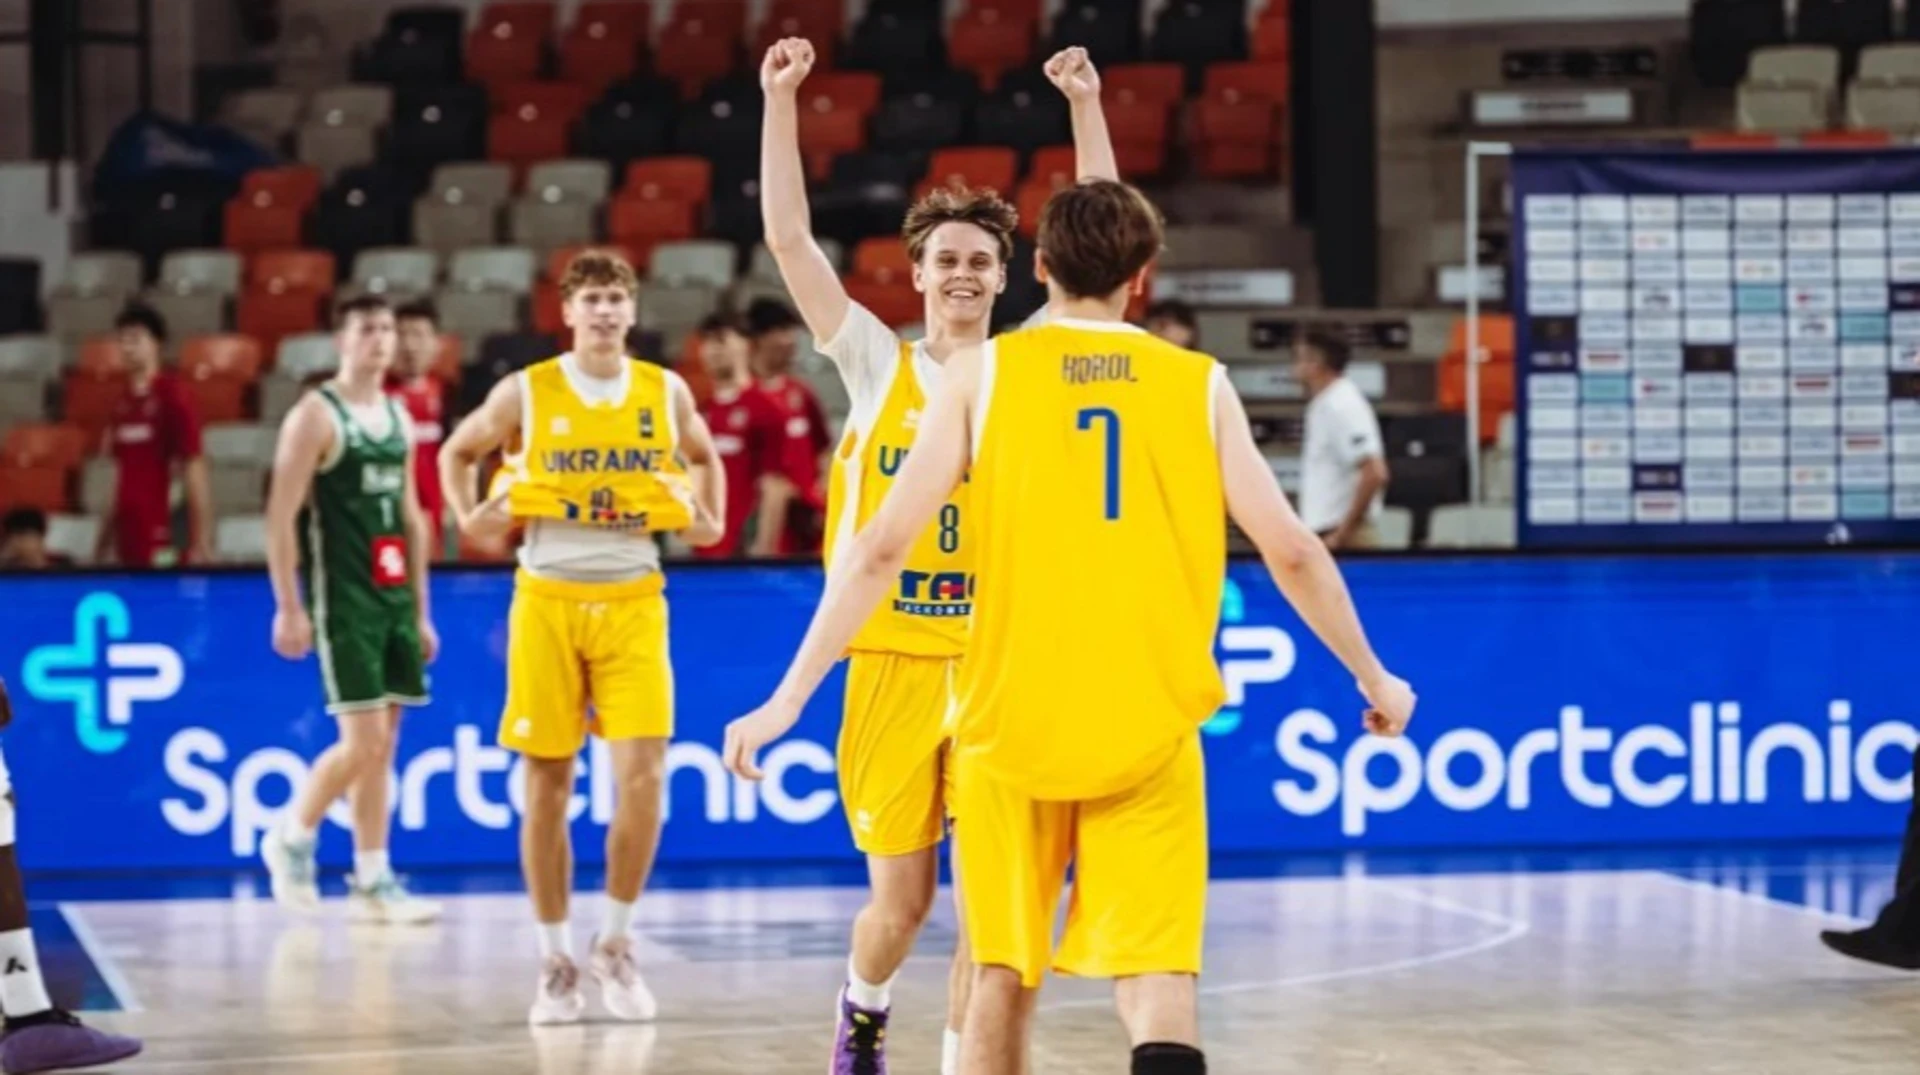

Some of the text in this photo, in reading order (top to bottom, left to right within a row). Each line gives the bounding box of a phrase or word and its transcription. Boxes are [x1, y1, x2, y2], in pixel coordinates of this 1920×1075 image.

[540, 448, 664, 473] UKRAINE
[1076, 406, 1121, 521] 7
[938, 503, 960, 554] 8
[1274, 701, 1920, 836] Sportclinic
